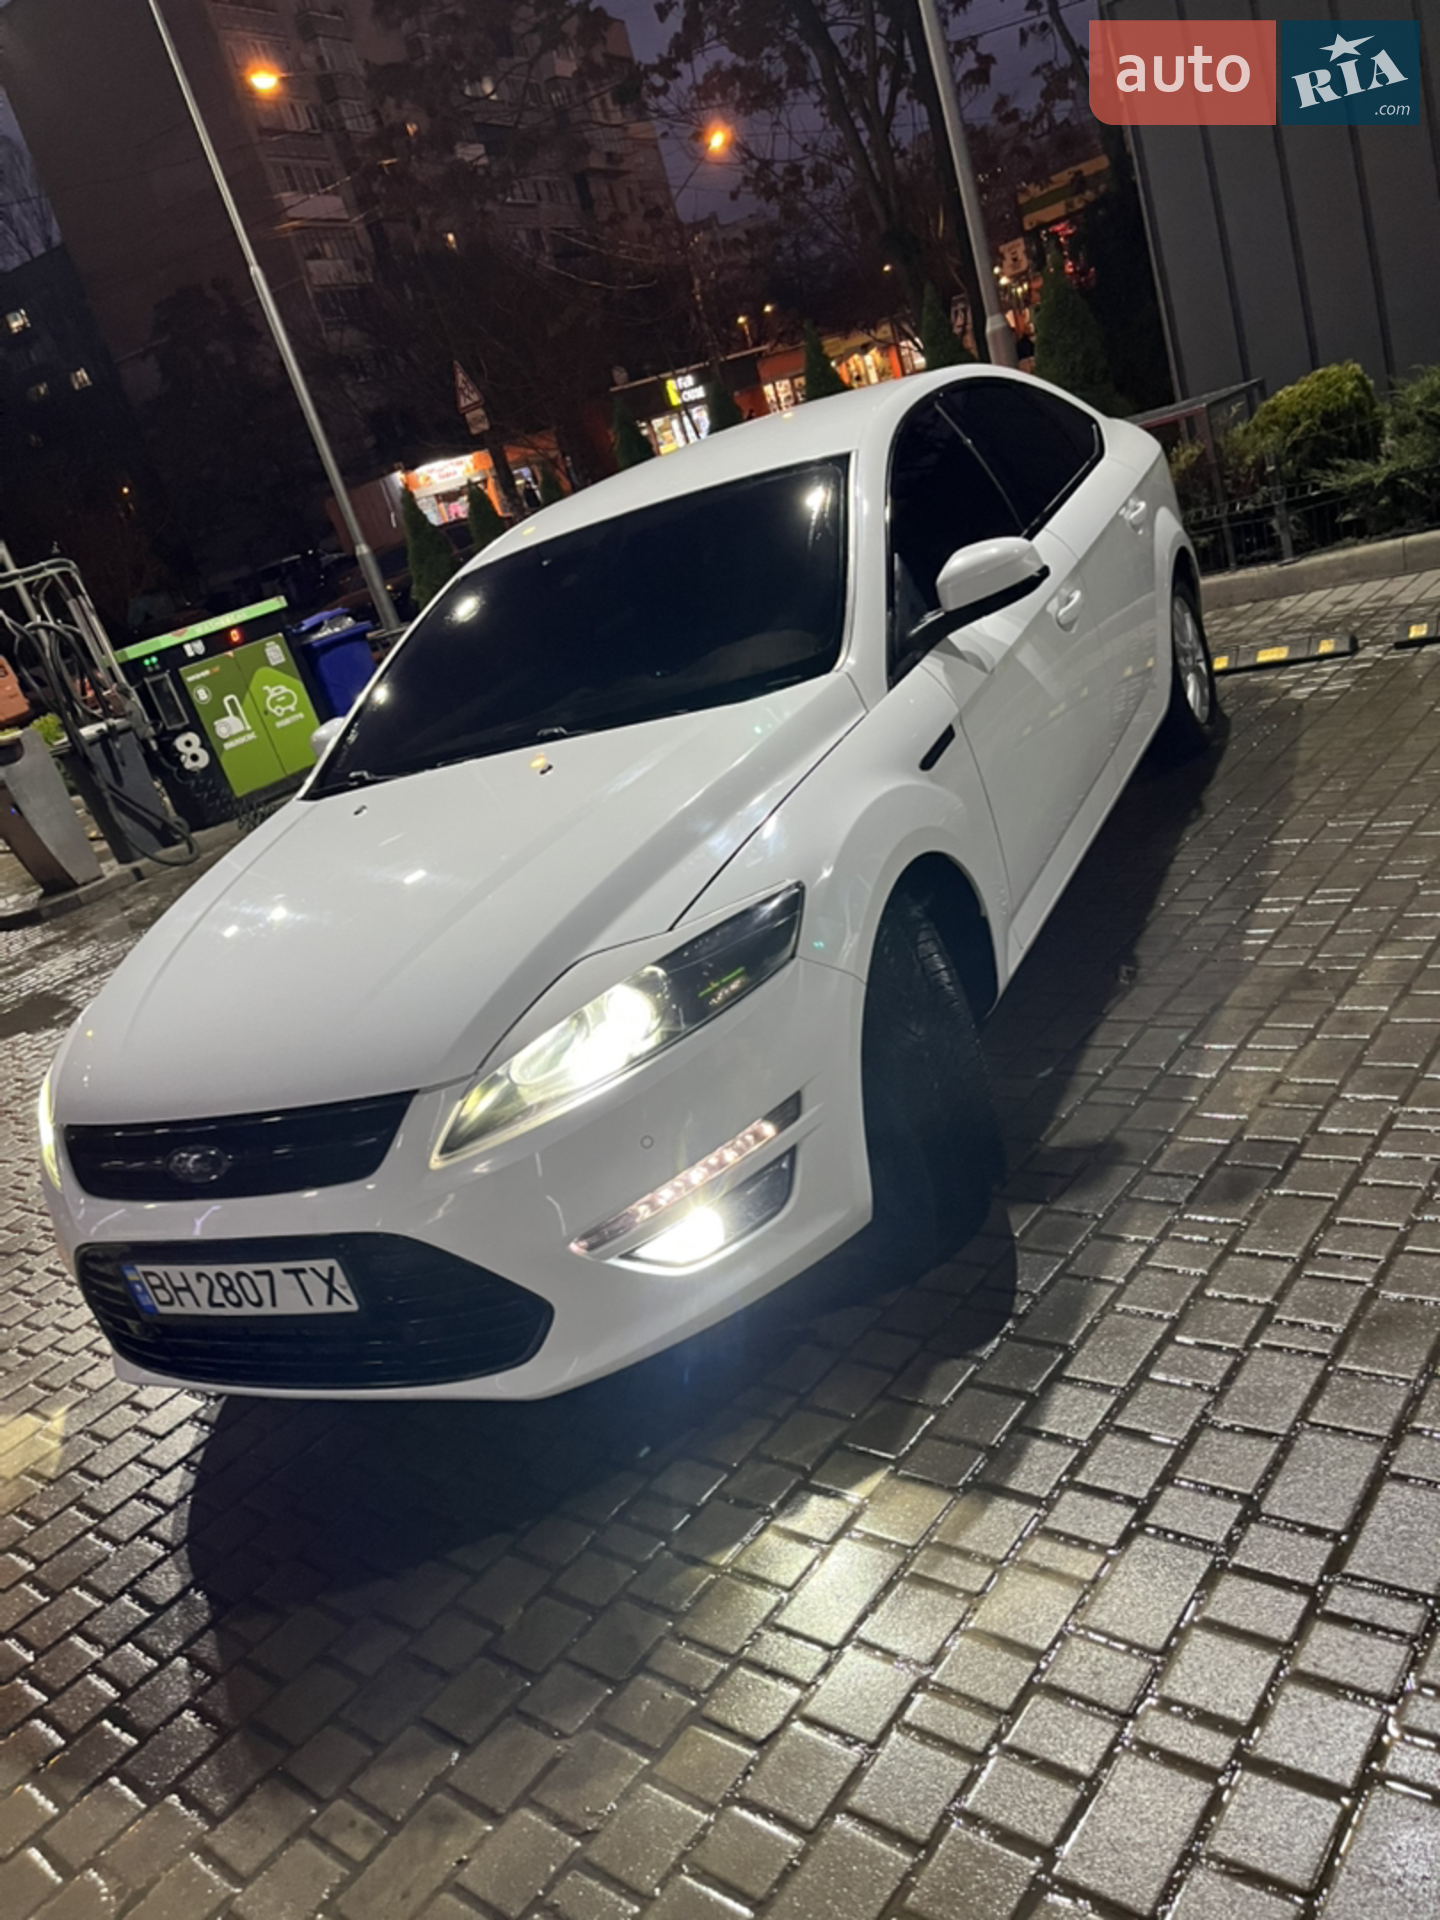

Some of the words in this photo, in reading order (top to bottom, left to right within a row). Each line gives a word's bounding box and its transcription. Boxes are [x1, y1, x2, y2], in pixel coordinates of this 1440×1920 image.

[174, 732, 210, 771] 8
[196, 1270, 277, 1308] 2807
[282, 1266, 353, 1306] TX
